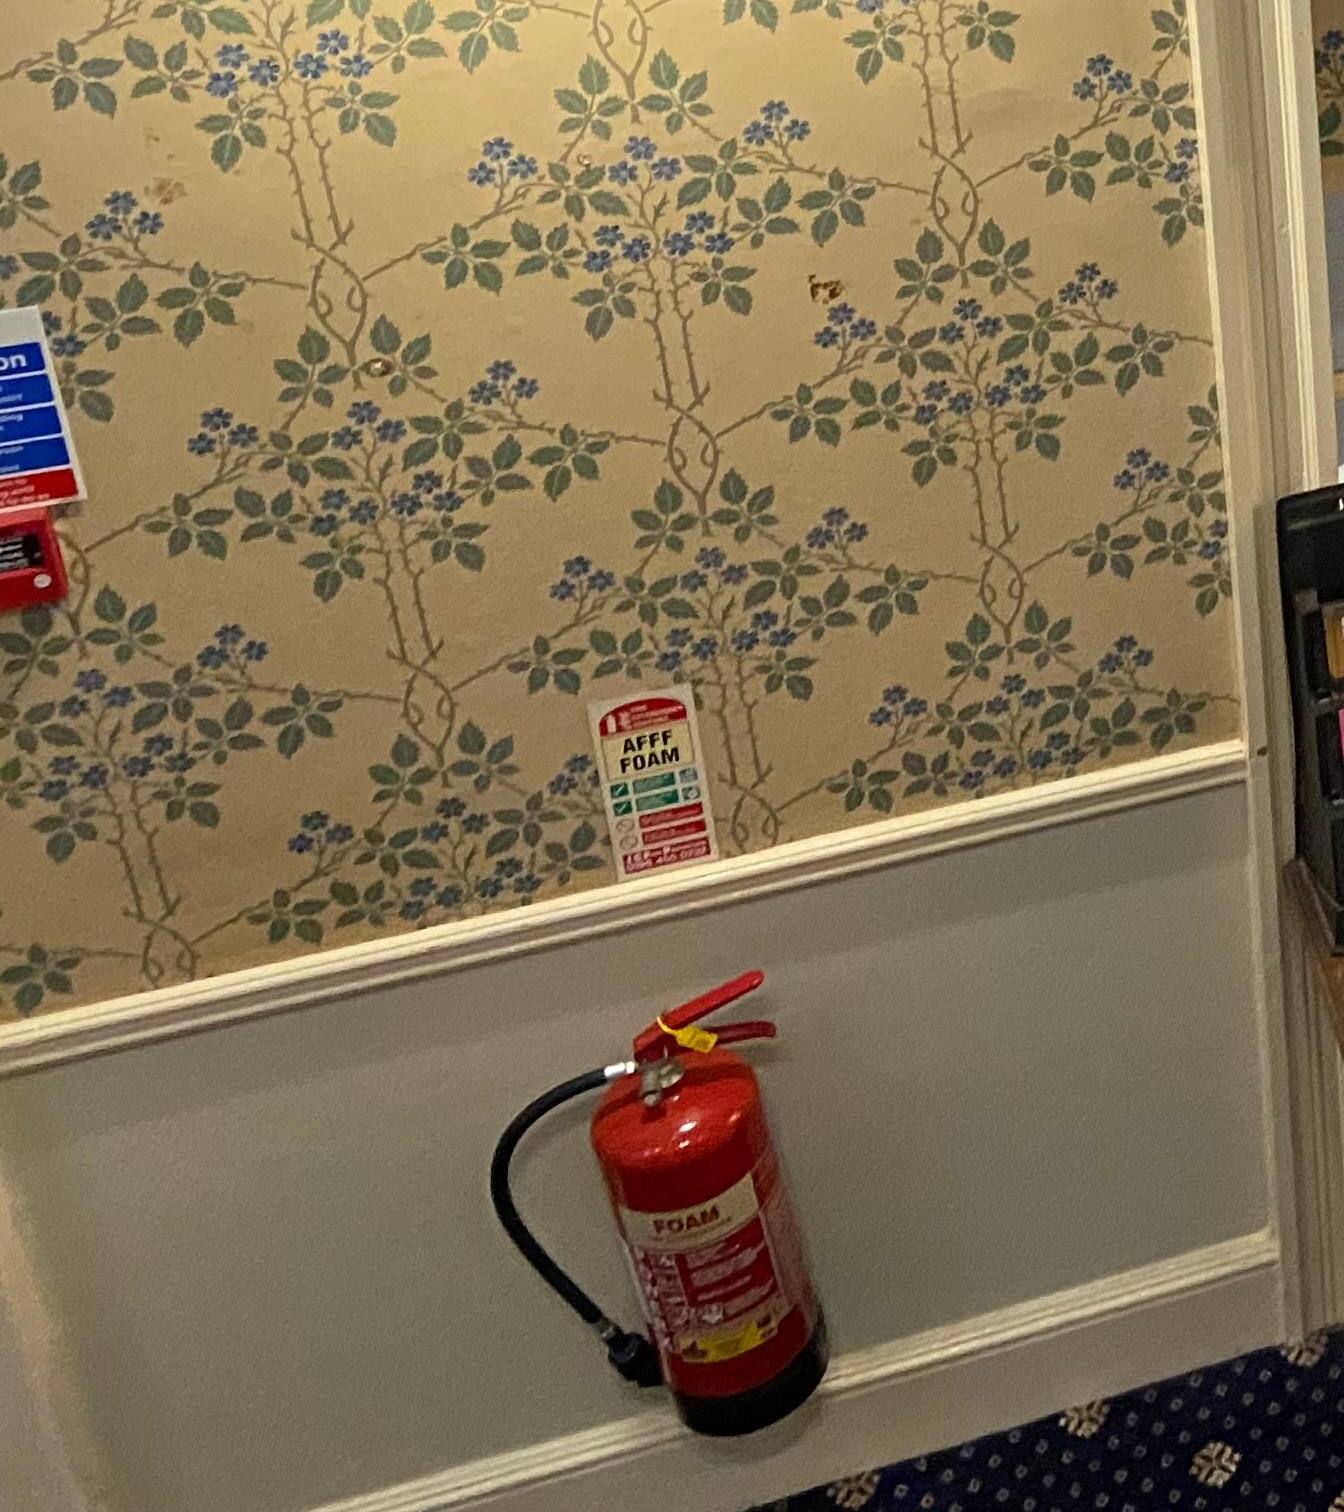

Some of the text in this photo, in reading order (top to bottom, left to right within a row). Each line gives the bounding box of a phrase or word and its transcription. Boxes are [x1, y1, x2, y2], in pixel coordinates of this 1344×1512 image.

[622, 728, 673, 755] AFFF
[619, 746, 680, 774] FOAM
[652, 1205, 721, 1234] FOAM
